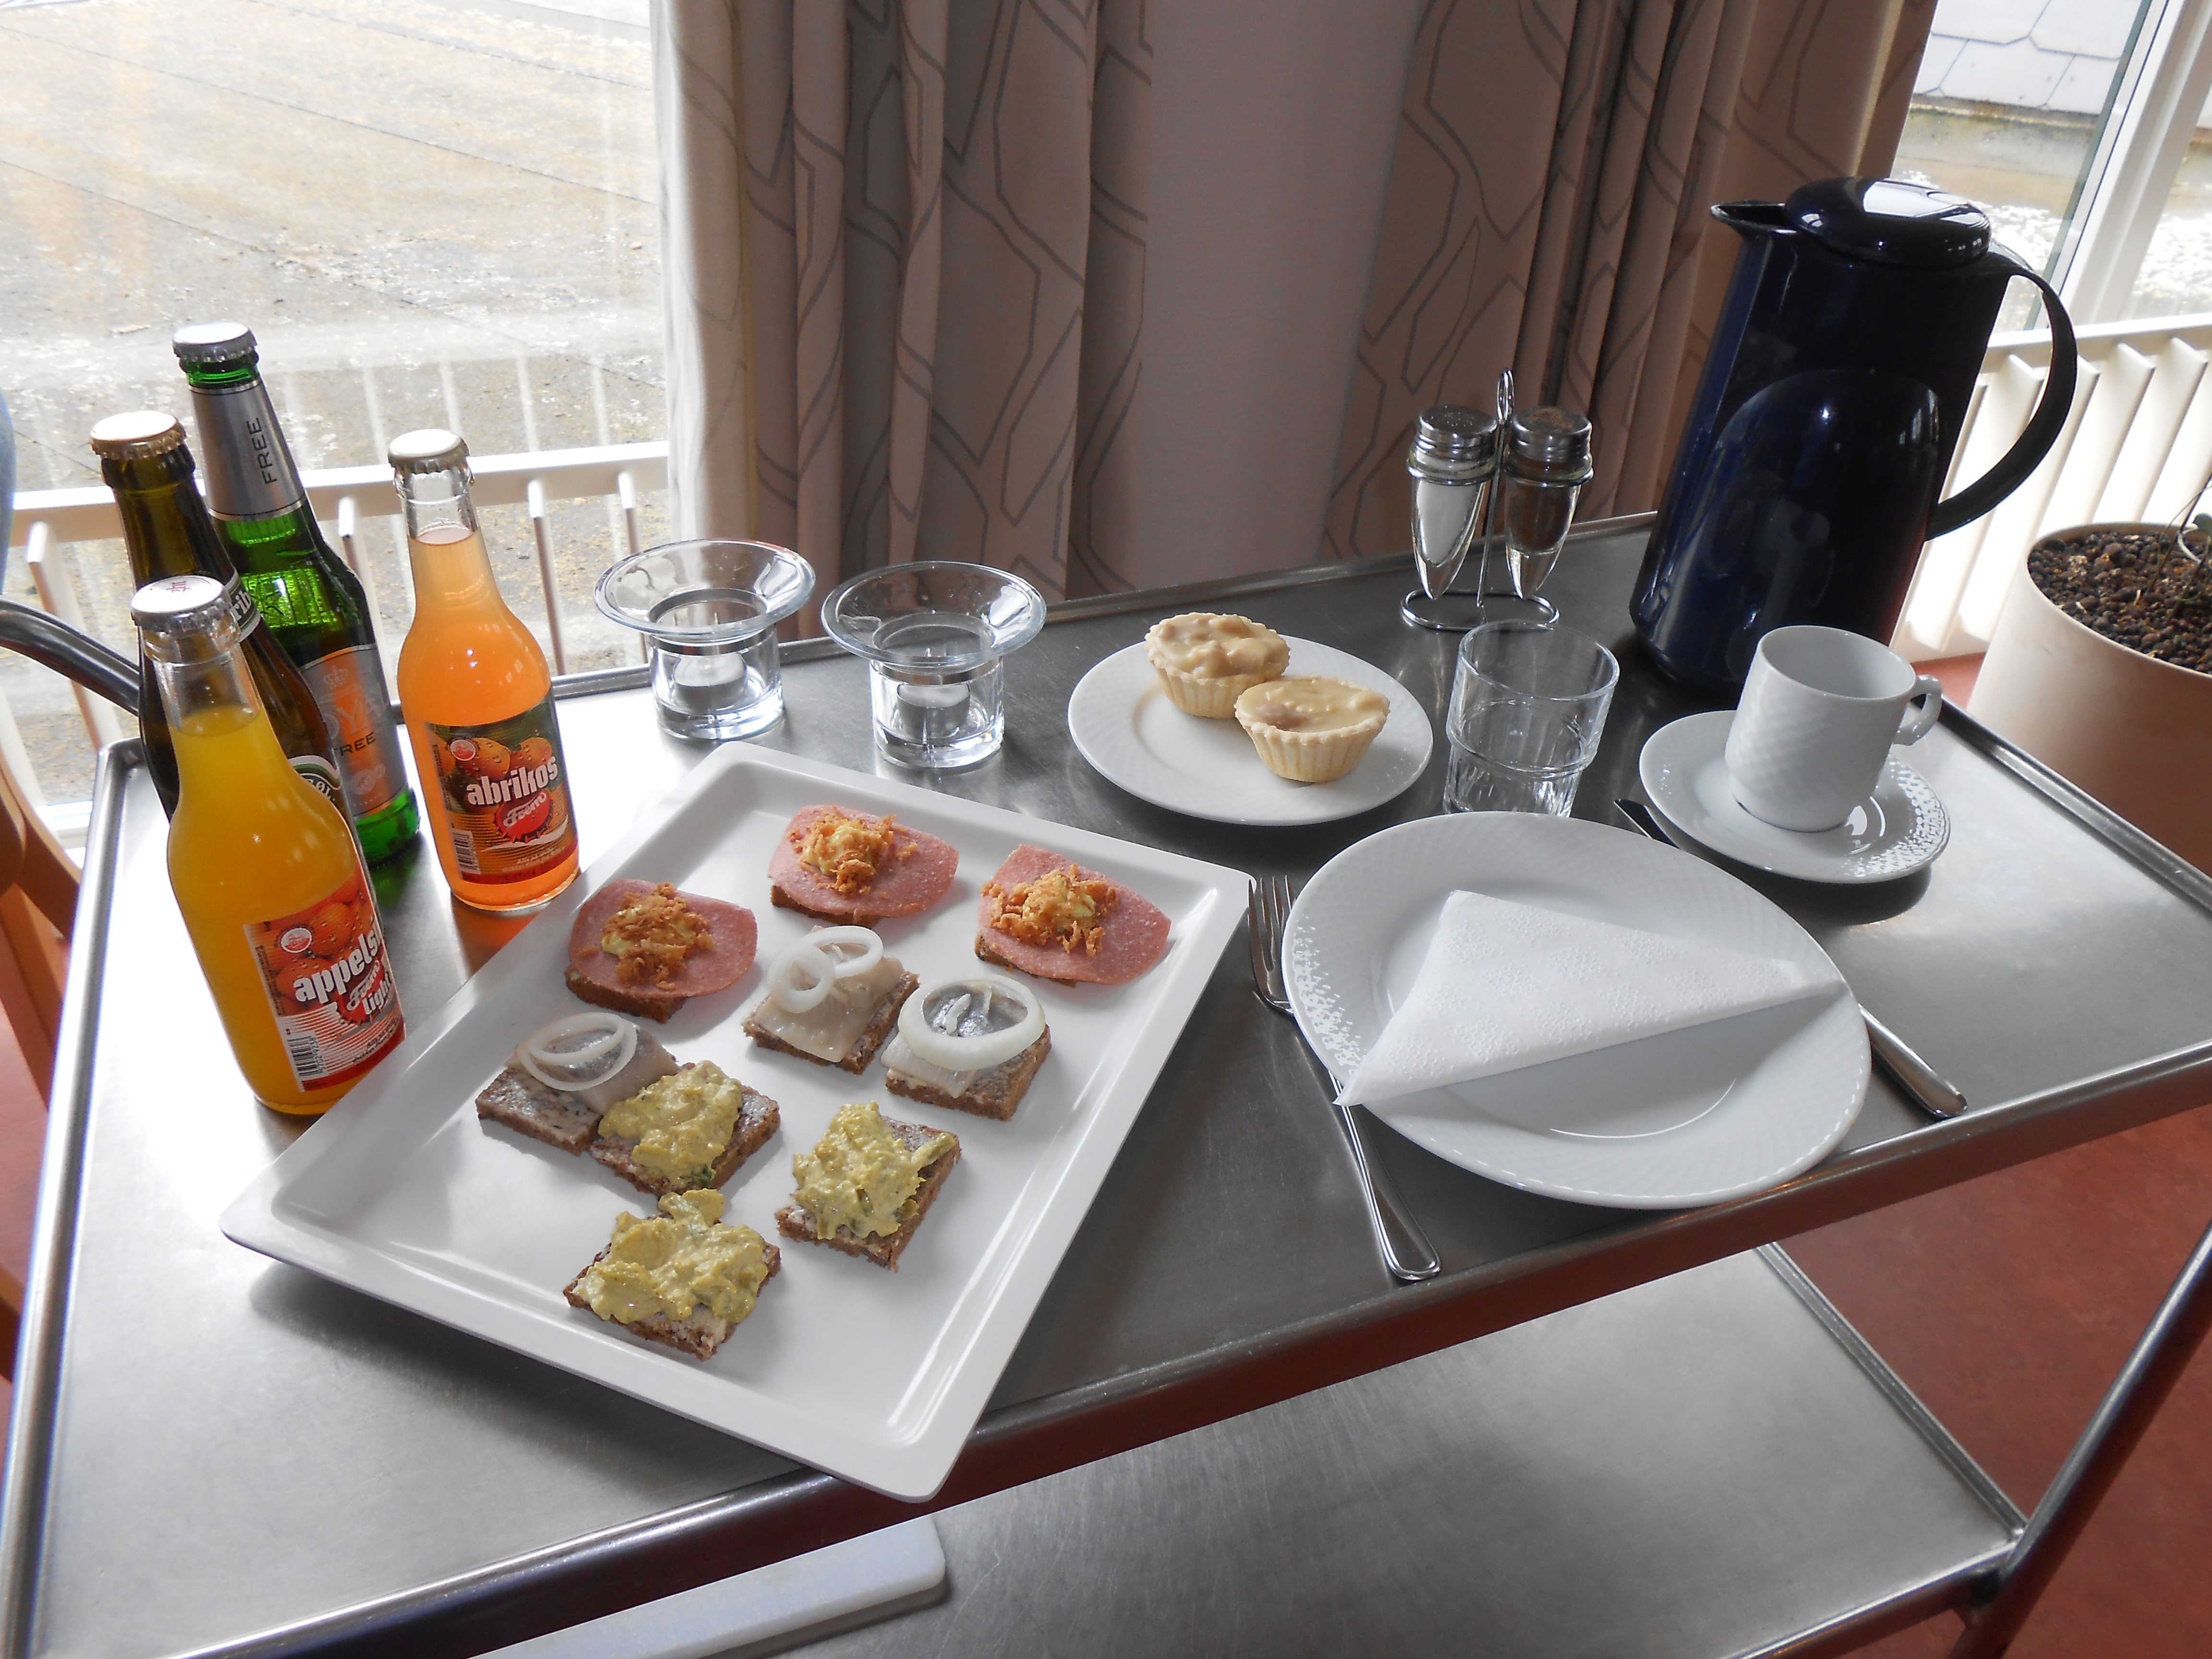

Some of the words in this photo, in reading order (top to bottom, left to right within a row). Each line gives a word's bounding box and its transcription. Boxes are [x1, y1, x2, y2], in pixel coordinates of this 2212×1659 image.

[246, 418, 277, 484] FREE
[334, 732, 377, 757] REE
[466, 756, 558, 805] abrikos
[293, 915, 384, 1005] appelsi
